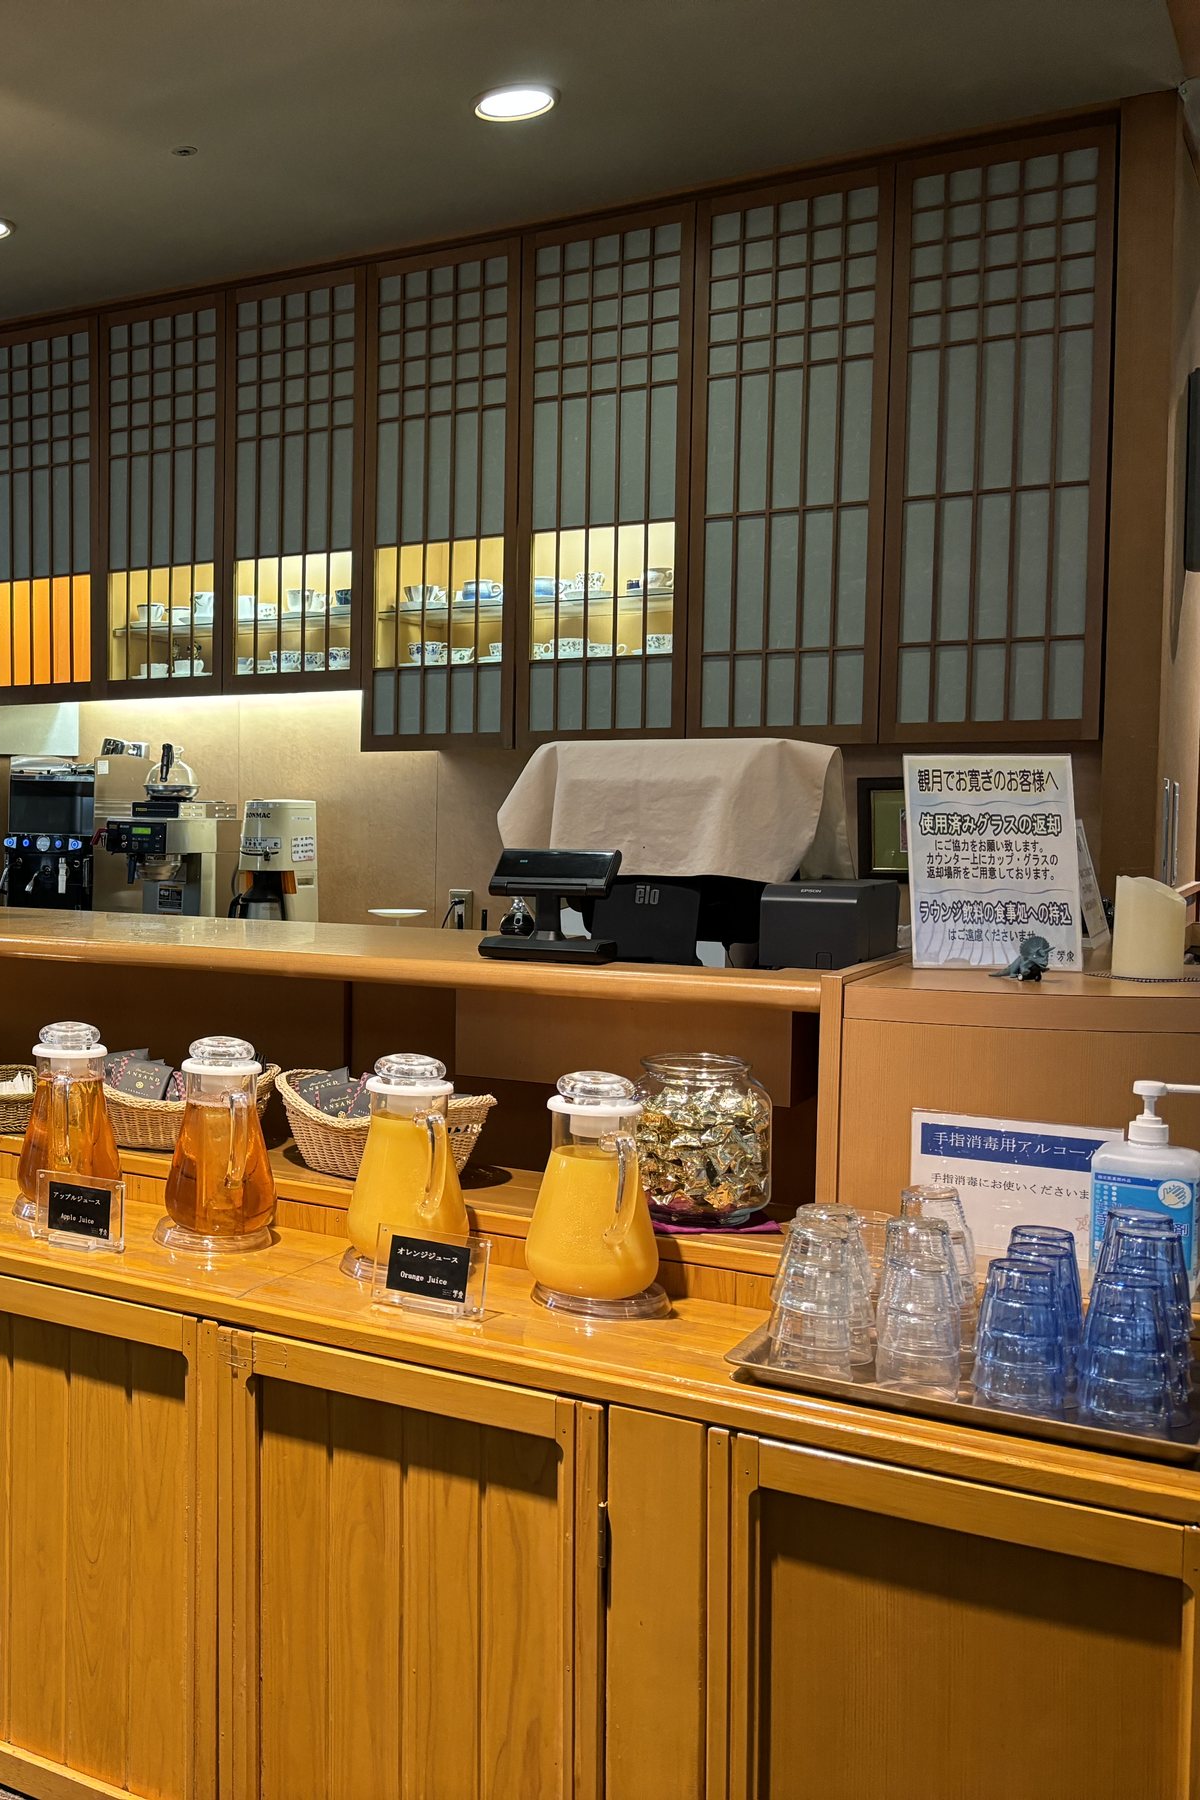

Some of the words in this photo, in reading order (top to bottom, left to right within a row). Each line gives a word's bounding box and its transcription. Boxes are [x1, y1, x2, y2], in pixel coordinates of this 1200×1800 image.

[917, 768, 1059, 793] 観月でお寛ぎのお客様へ
[919, 812, 1062, 837] 使用済みグラスの返却
[934, 840, 1044, 853] にご協力をお願い致します。
[926, 853, 1058, 867] カウンター上にカップ・グラスの
[926, 866, 1055, 881] 返却場所をご用意しております。
[920, 900, 1073, 925] ラウンジ飲料の食事処への持込
[931, 1173, 1089, 1200] 手指消毒にお使いくださいま
[53, 1191, 101, 1205] アップルジュース
[61, 1213, 76, 1221] Apple
[78, 1215, 94, 1225] Juice
[397, 1247, 459, 1264] オレンジジュース
[400, 1271, 424, 1282] Orange
[427, 1275, 448, 1286] Juice
